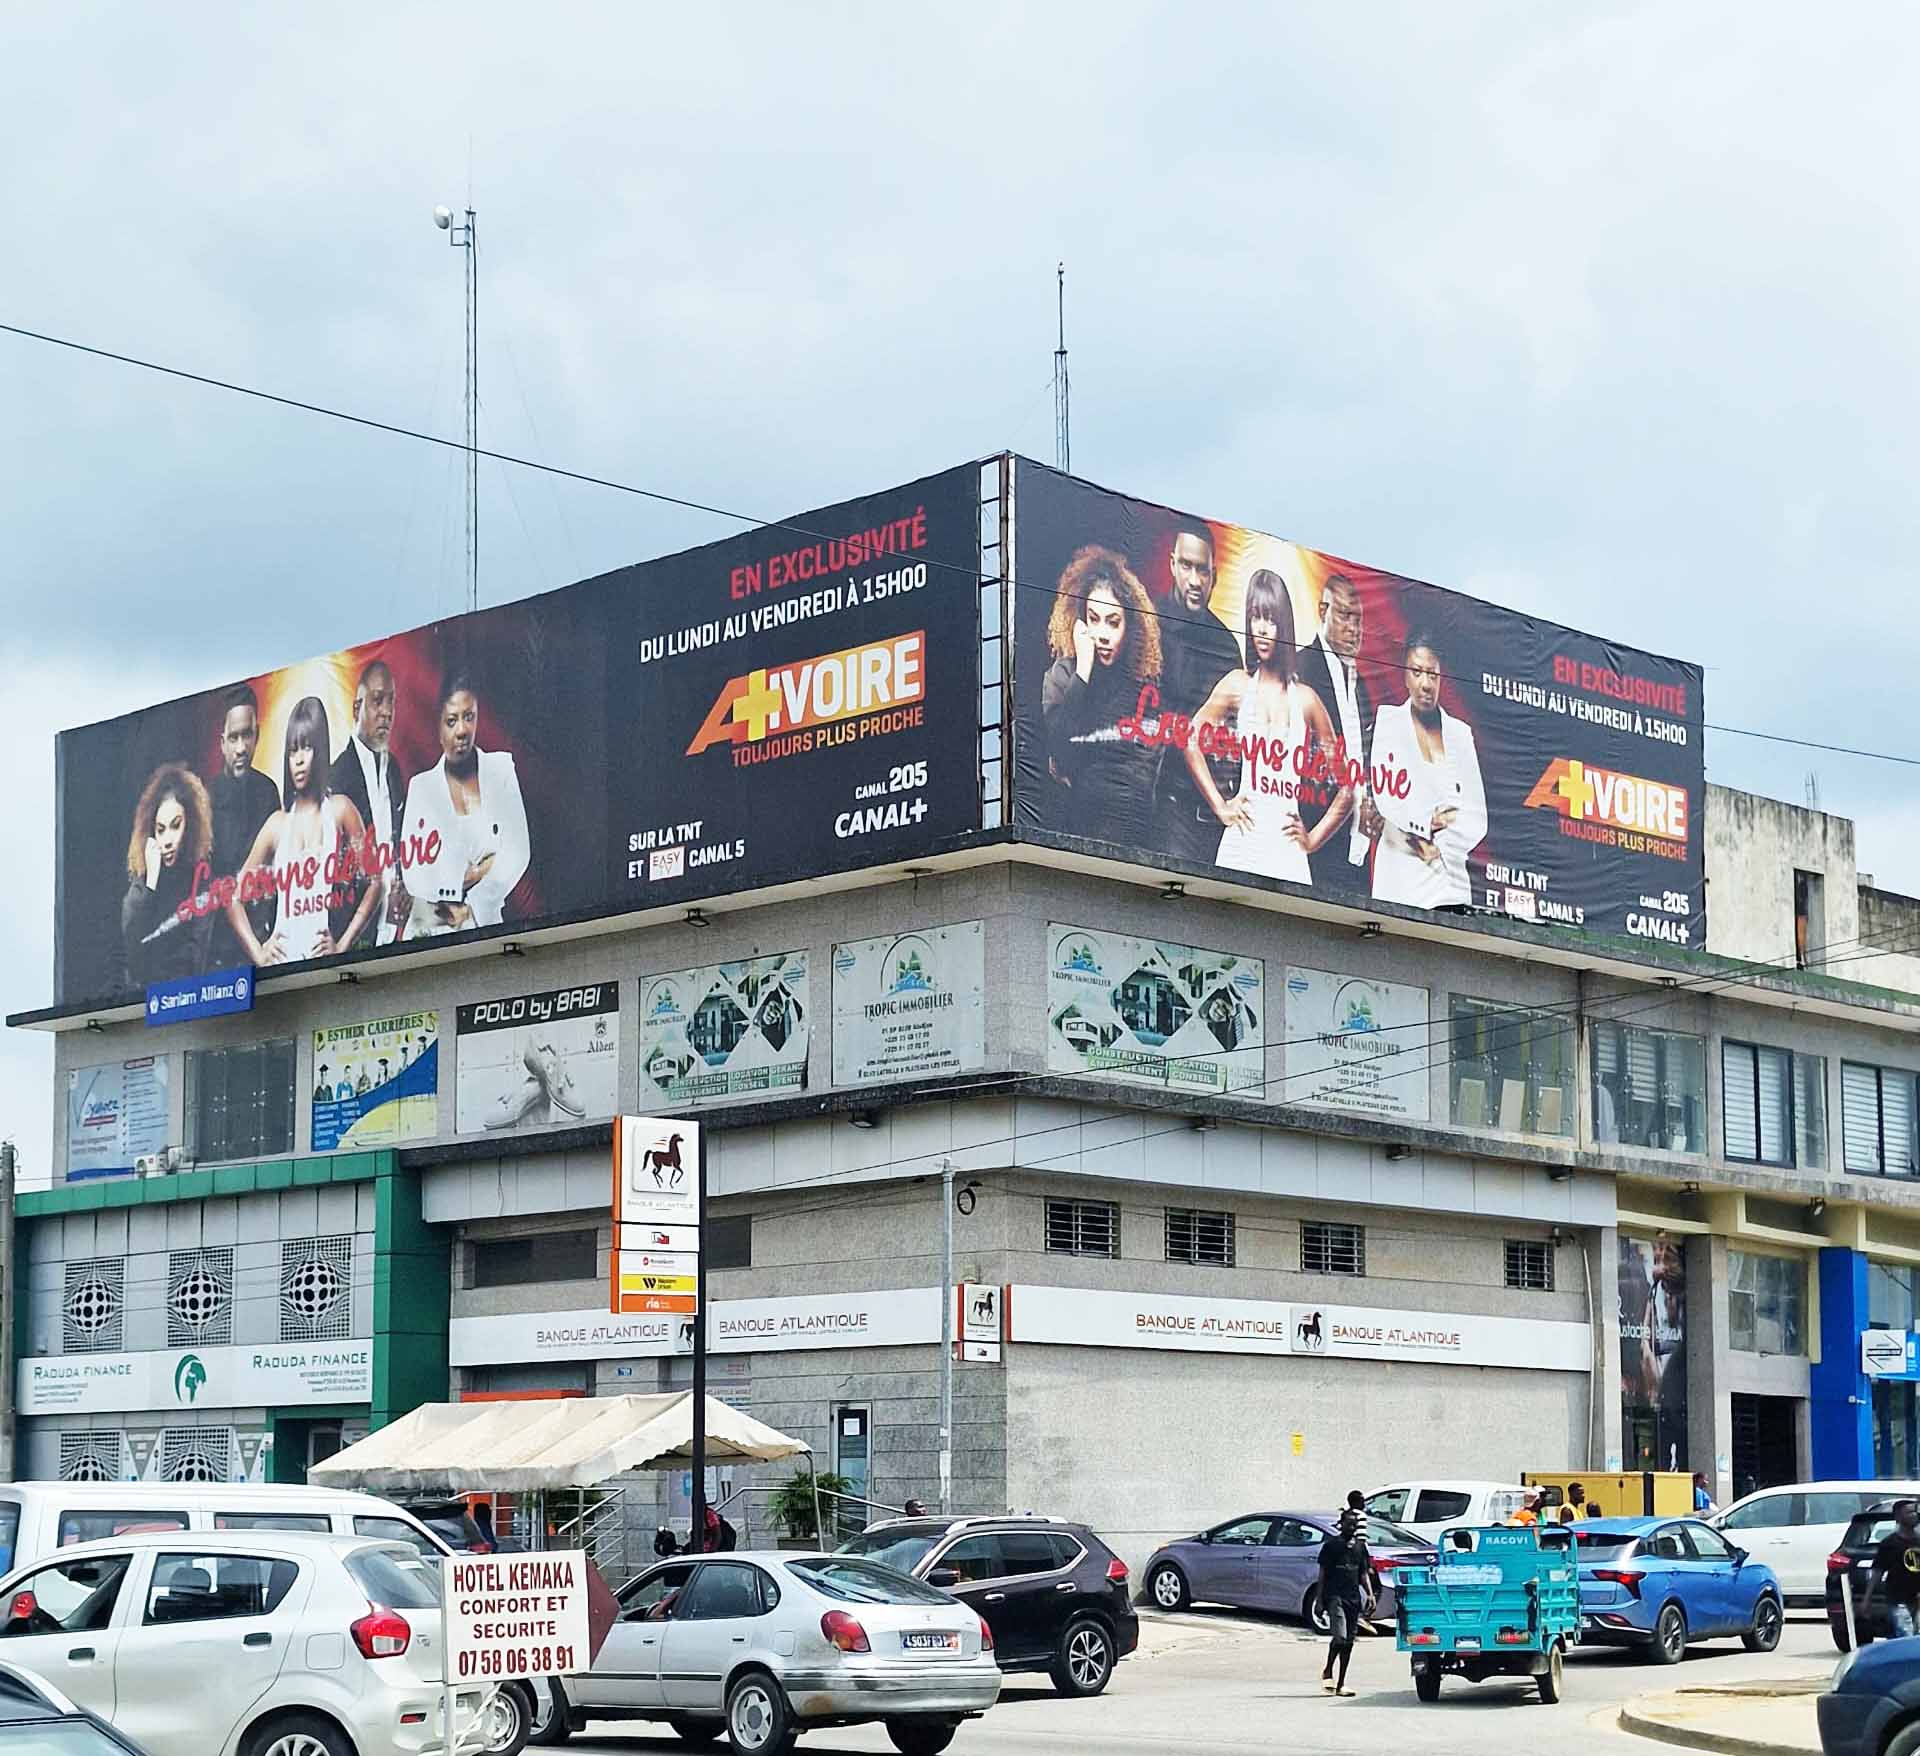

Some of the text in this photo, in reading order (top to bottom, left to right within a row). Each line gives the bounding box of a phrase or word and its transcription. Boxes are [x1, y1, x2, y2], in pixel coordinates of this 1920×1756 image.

[731, 505, 927, 600] EN EXCLUSIVITÉ
[640, 563, 927, 663] DU LUNDI AU VENDREDI À 15H00
[1553, 655, 1687, 715] EN EXCLUSIVITÉ
[1482, 672, 1687, 746] DU LUNDI AU VENDREDI À 15H00
[731, 706, 924, 768] TOUJOURS PLUS PROCHE
[1199, 720, 1288, 791] coups
[1293, 721, 1329, 781] de
[1332, 733, 1366, 787] la
[1371, 752, 1412, 800] vie
[855, 761, 928, 800] CANAL 205
[1260, 775, 1317, 805] SAISON
[834, 797, 928, 839] CANAL+
[628, 820, 702, 852] SUR LA TNT
[1559, 818, 1688, 862] TOUJOURS PLUS PROCHE
[241, 855, 321, 918] coups
[324, 830, 356, 883] de
[400, 818, 442, 870] vie
[628, 839, 745, 879] ET EASY CANAL 5
[1486, 863, 1548, 892] SUR LA TNT
[293, 891, 343, 918] SAISON
[1486, 889, 1500, 907] ET
[1538, 900, 1574, 923] CANAL
[1575, 907, 1585, 925] 5
[1639, 890, 1690, 915] CANAL 205
[1626, 913, 1690, 944] CANAL+
[200, 984, 235, 1002] Allianz
[473, 986, 602, 1025] POLO by BABI
[864, 992, 954, 1018] TROPIC IMMOBILIER
[327, 1025, 366, 1042] ESTHER
[1088, 1046, 1165, 1066] CONSTRUCTION
[536, 1323, 669, 1343] BANQUE ATLANTIQUE
[719, 1317, 775, 1334] BANQUE
[780, 1312, 868, 1331] ATLANTIQUE
[1136, 1313, 1196, 1330] BANQUE
[1201, 1318, 1283, 1335] ATLANTIQUE
[1332, 1324, 1383, 1341] BANQUE
[1387, 1328, 1461, 1346] ATLANTIQUE
[84, 1363, 133, 1377] FINANCE
[253, 1352, 368, 1368] RAOUDA FINANCE
[1485, 1536, 1528, 1545] RACOVI
[454, 1561, 574, 1593] HOTEL KEMAKA
[460, 1595, 568, 1615] CONFORT ET
[473, 1620, 556, 1639] SECURITE
[506, 1648, 528, 1673] 06
[531, 1647, 551, 1672] 38
[556, 1645, 574, 1670] 91
